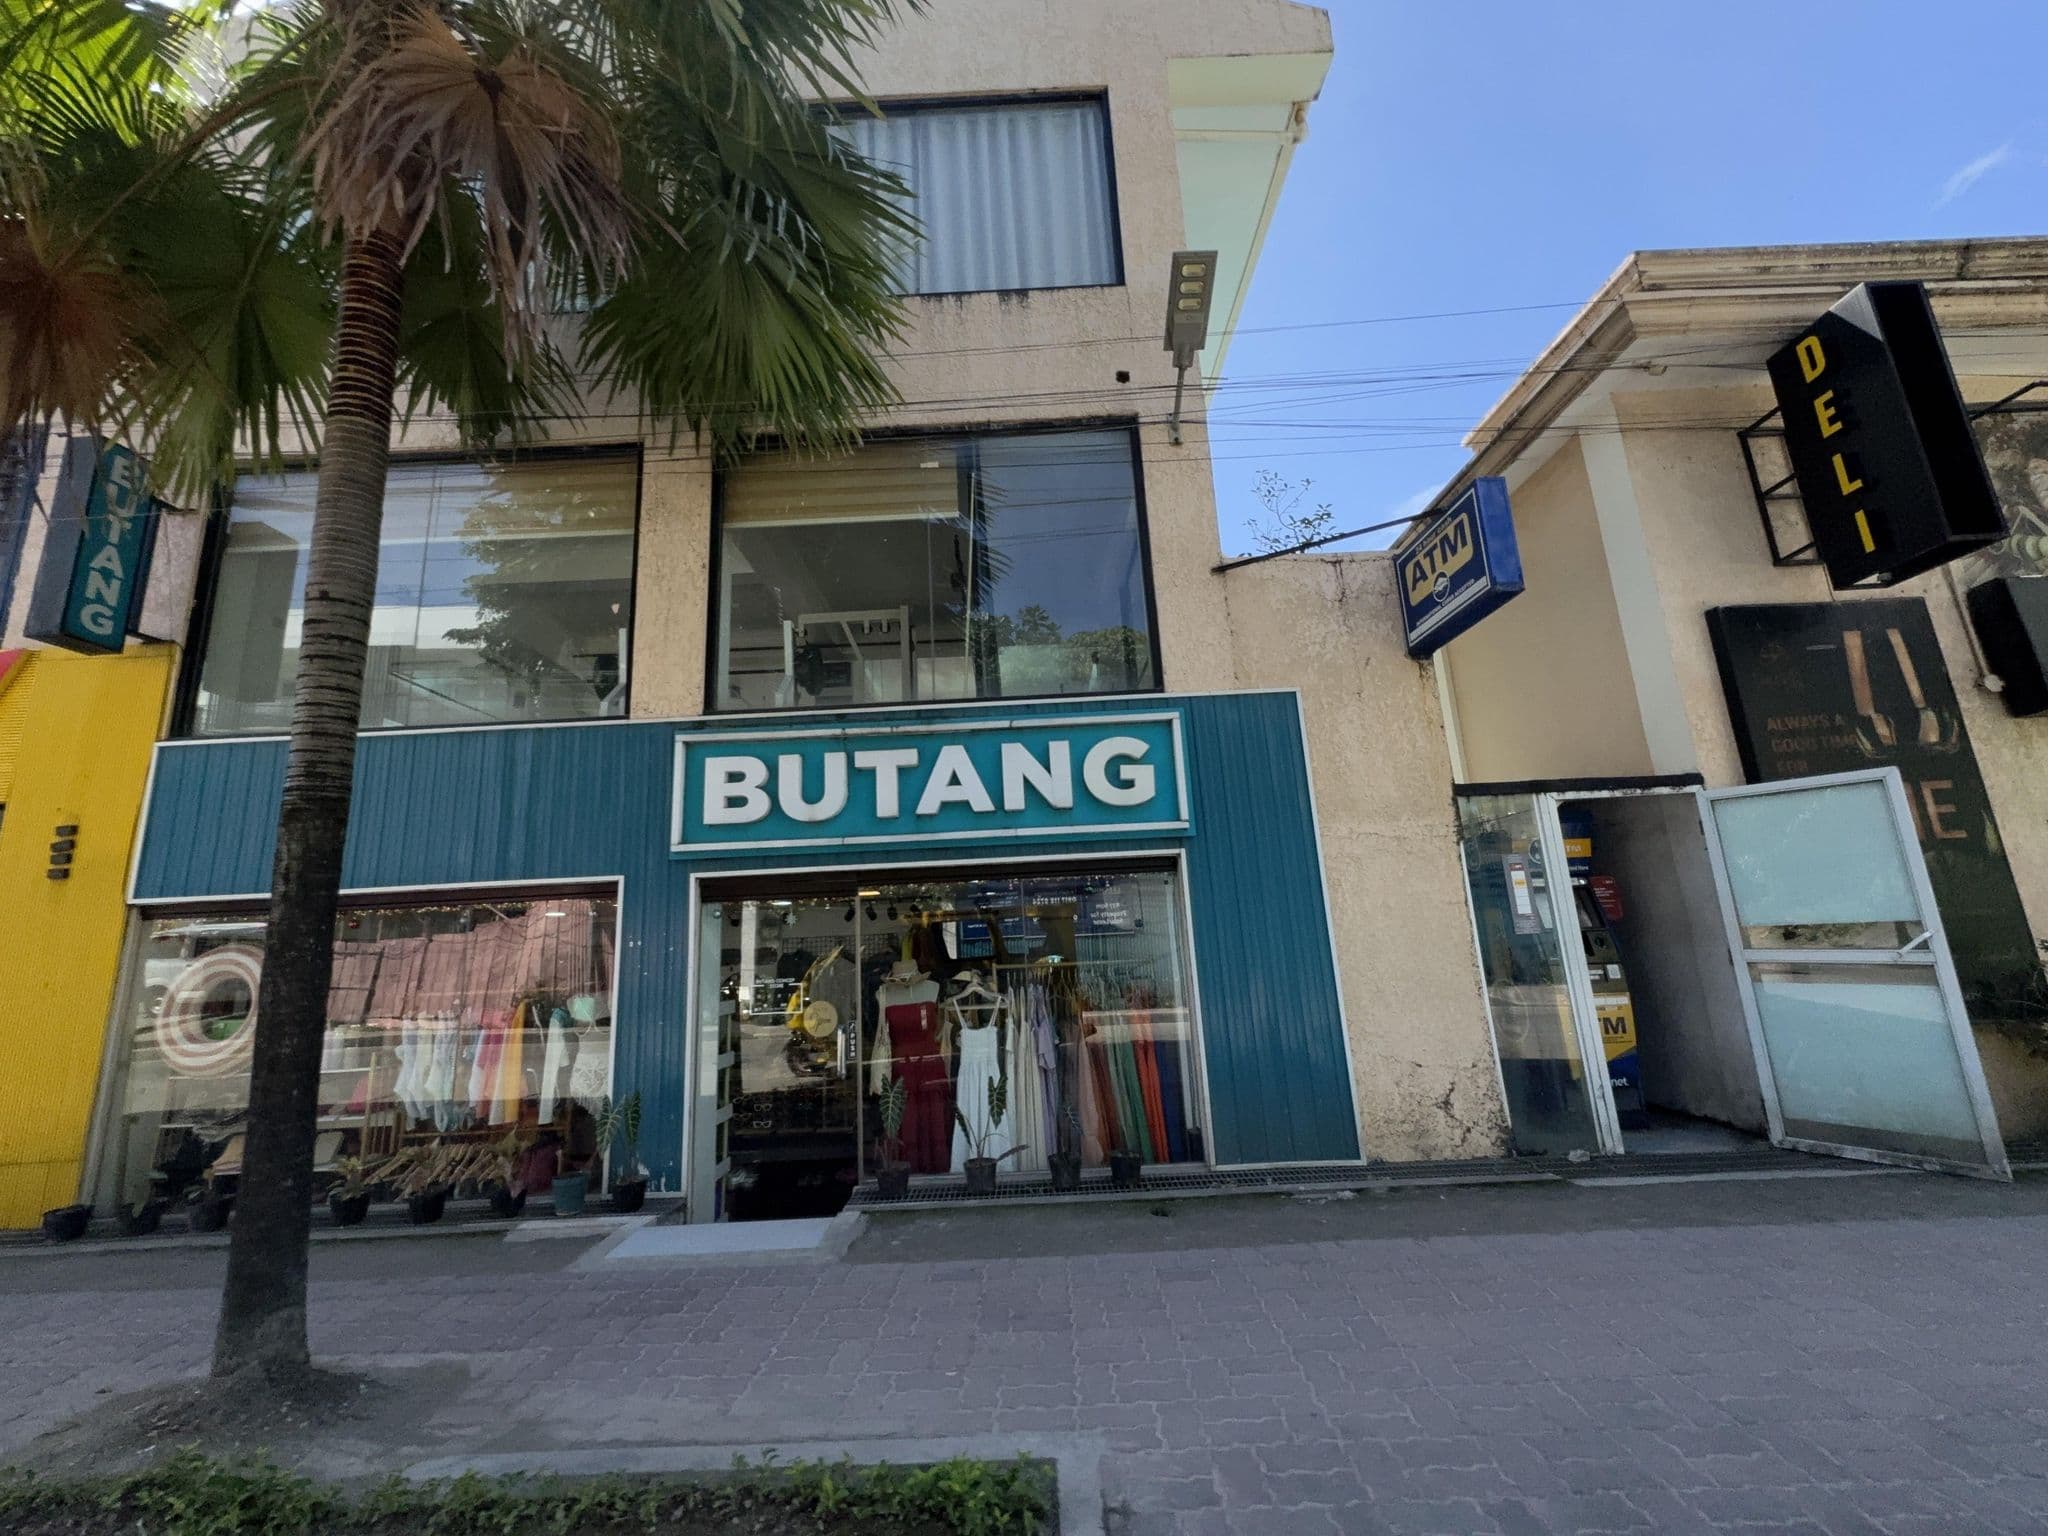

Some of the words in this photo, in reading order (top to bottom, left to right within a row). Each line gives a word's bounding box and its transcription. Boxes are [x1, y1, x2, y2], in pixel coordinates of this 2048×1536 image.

[1796, 335, 1876, 554] DELI
[1411, 518, 1468, 592] ATM
[703, 736, 1157, 825] BUTANG
